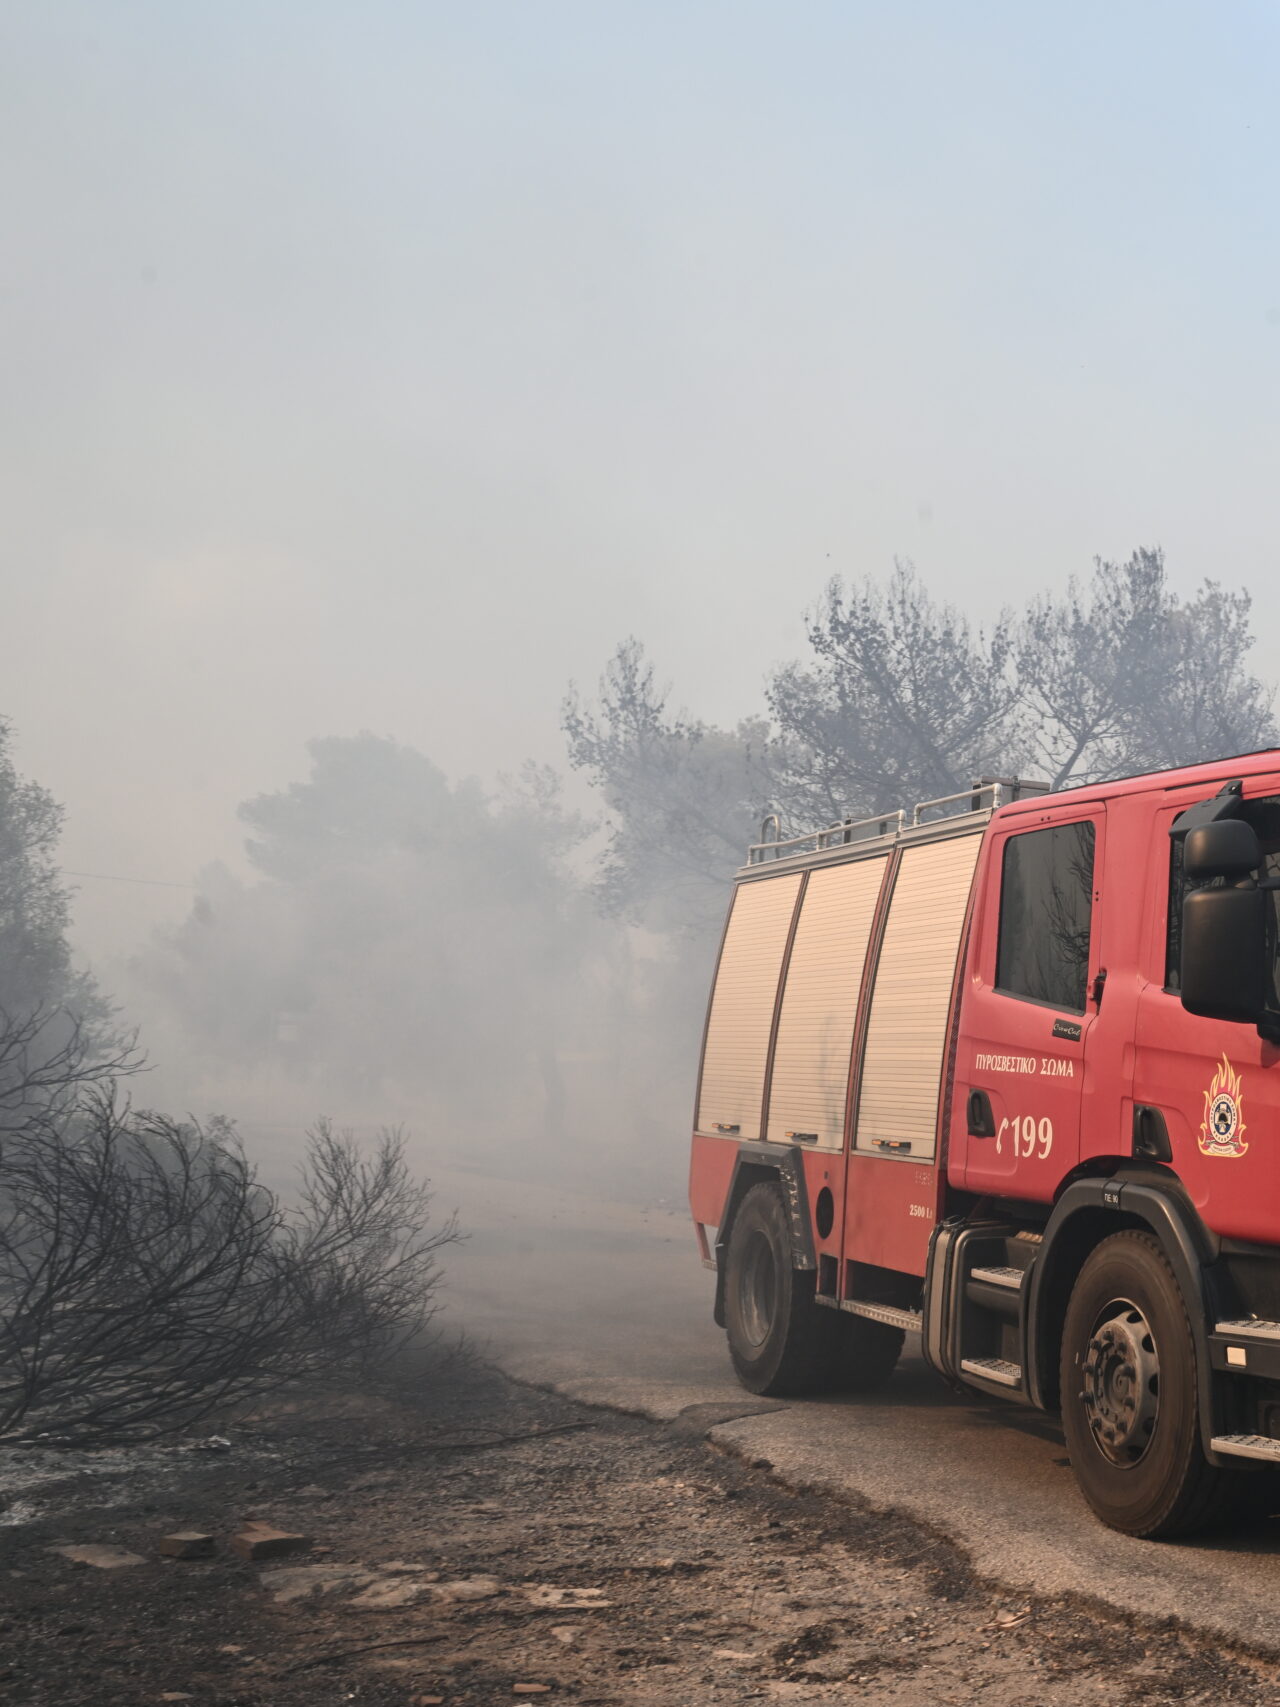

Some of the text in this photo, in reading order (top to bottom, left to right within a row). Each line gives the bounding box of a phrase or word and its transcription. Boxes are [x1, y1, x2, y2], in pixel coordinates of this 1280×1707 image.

[975, 1054, 1075, 1077] ΠΥΡΟΣΒΕΣΤΙΚΟ ΣΩΜΑ
[1011, 1115, 1053, 1159] 199
[909, 1204, 926, 1218] 2500
